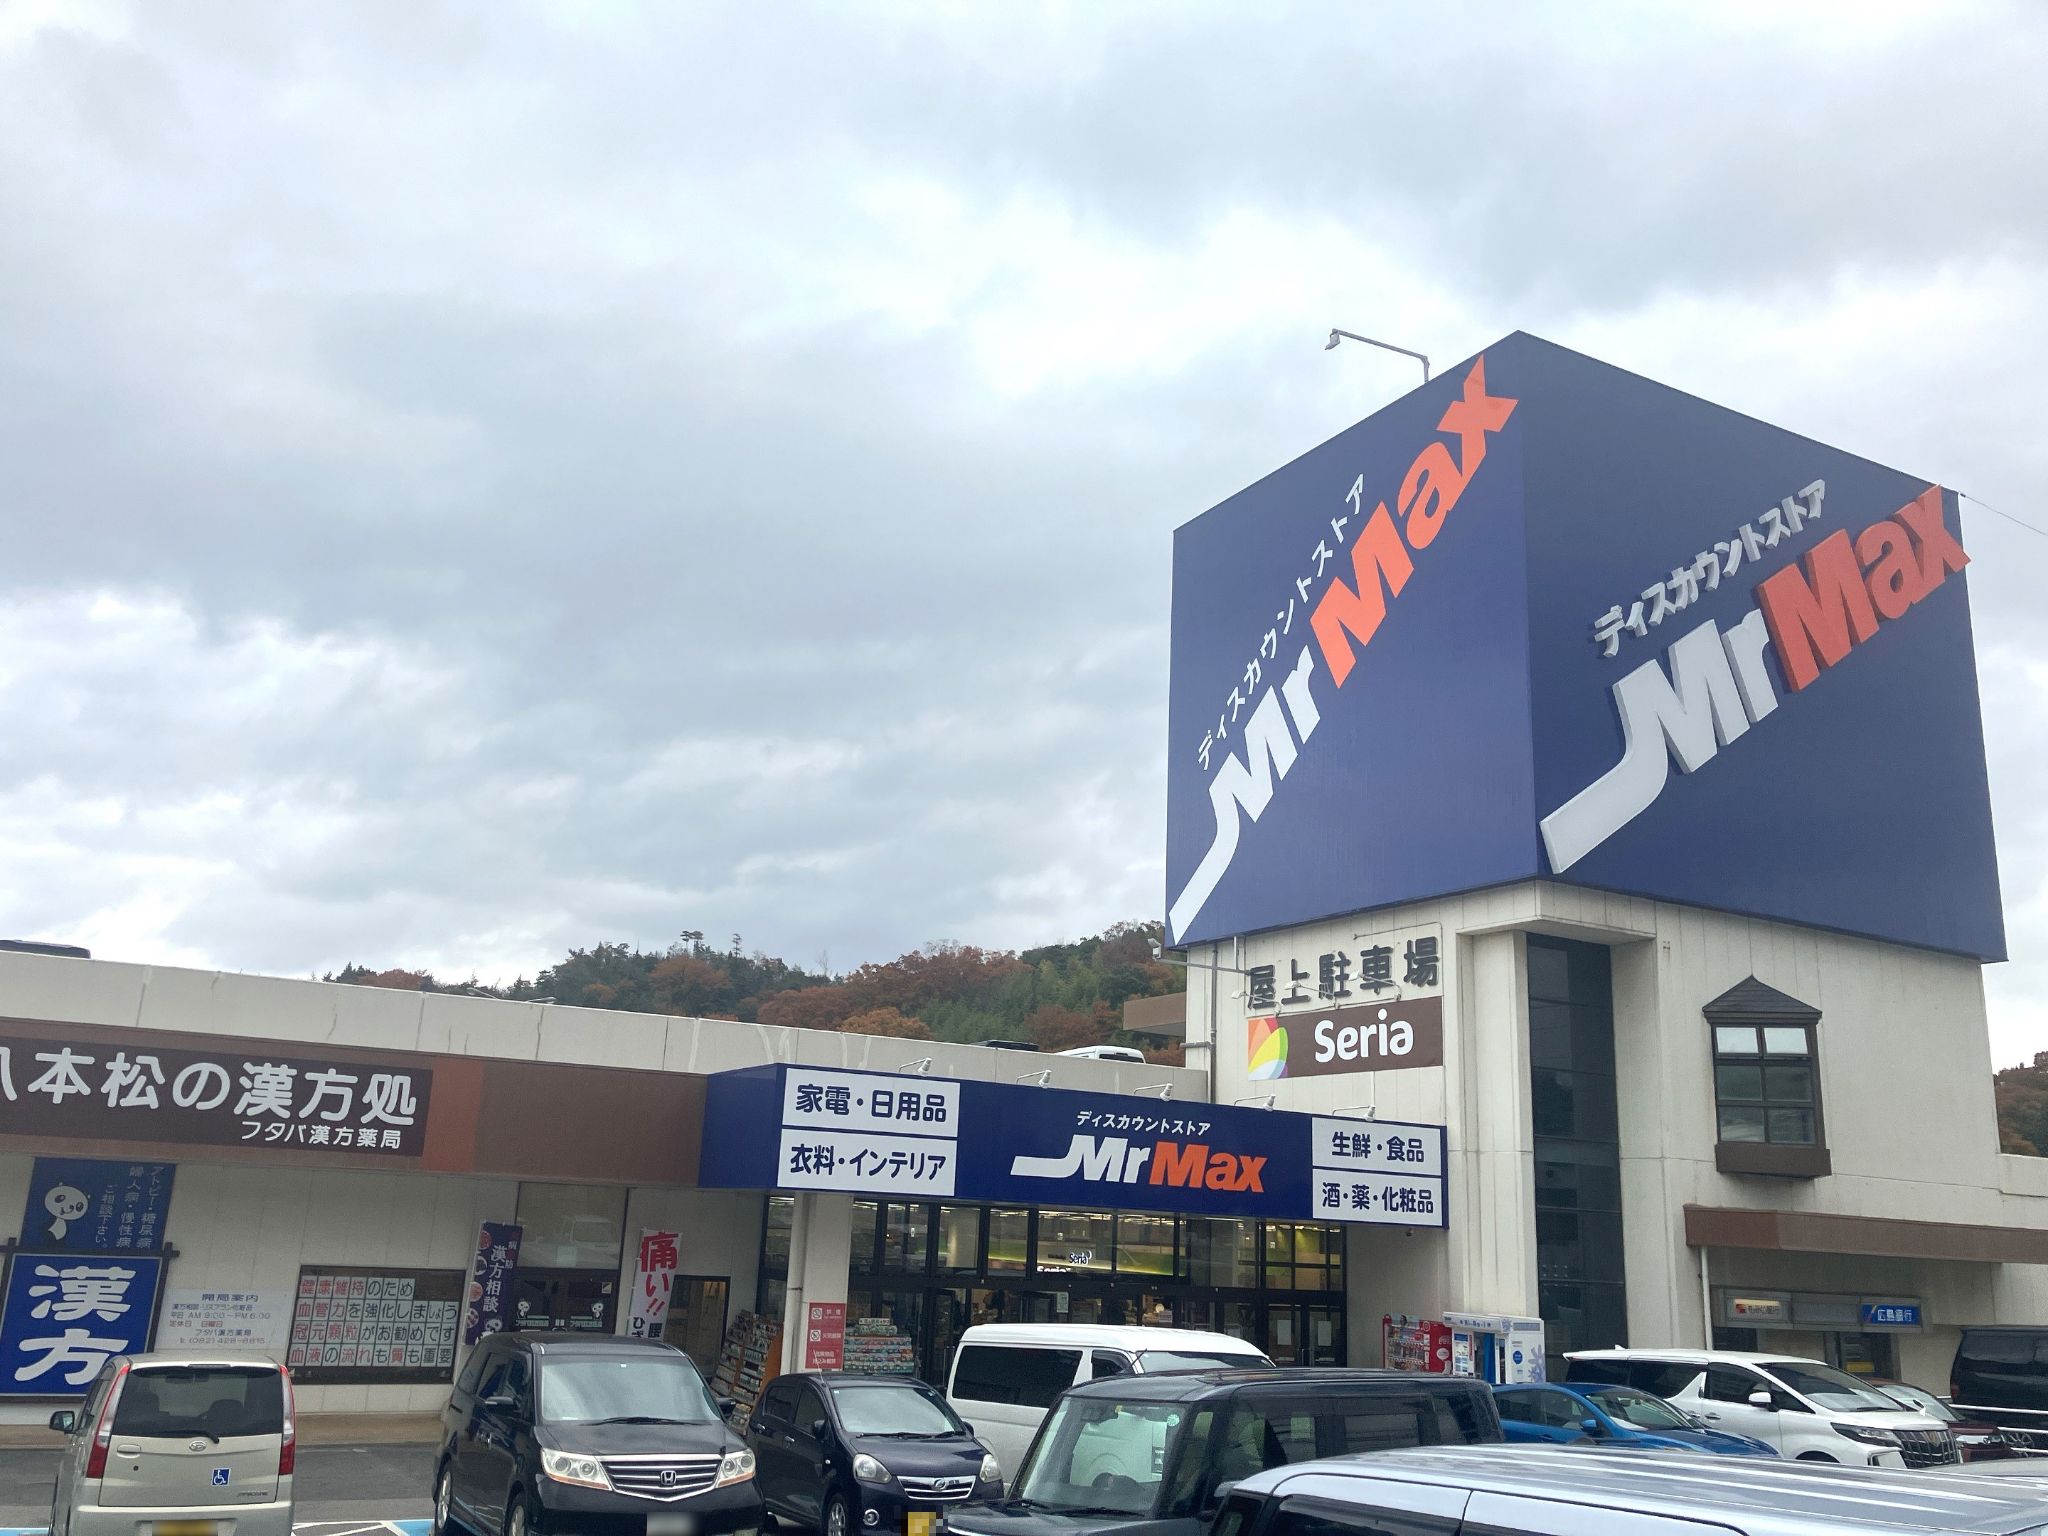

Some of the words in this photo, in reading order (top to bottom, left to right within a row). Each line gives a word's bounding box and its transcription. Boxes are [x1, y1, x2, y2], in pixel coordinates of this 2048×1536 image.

[1592, 479, 1826, 658] ディスカウントストア
[1197, 473, 1365, 770] ディスカウントストア
[1247, 936, 1440, 1010] 屋上駐車場
[1314, 1008, 1414, 1063] Seria
[795, 1083, 947, 1123] 家電・日用品
[240, 1120, 402, 1149] フタバ漢方薬局
[1076, 1110, 1211, 1136] ディスカウントストア
[790, 1143, 947, 1180] 衣料・インテリア
[1331, 1131, 1425, 1163] 生鮮・食品
[1321, 1181, 1434, 1214] 酒・薬・化粧品
[301, 1278, 414, 1298] 健康維持のため
[482, 1244, 508, 1313] 漢方相談
[14, 1264, 136, 1386] 漢方
[296, 1302, 457, 1320] 血管力を強化しましょう
[293, 1323, 455, 1343] 冠元顆粒がお勧めです
[290, 1347, 452, 1365] 血液の流れも質も重要
